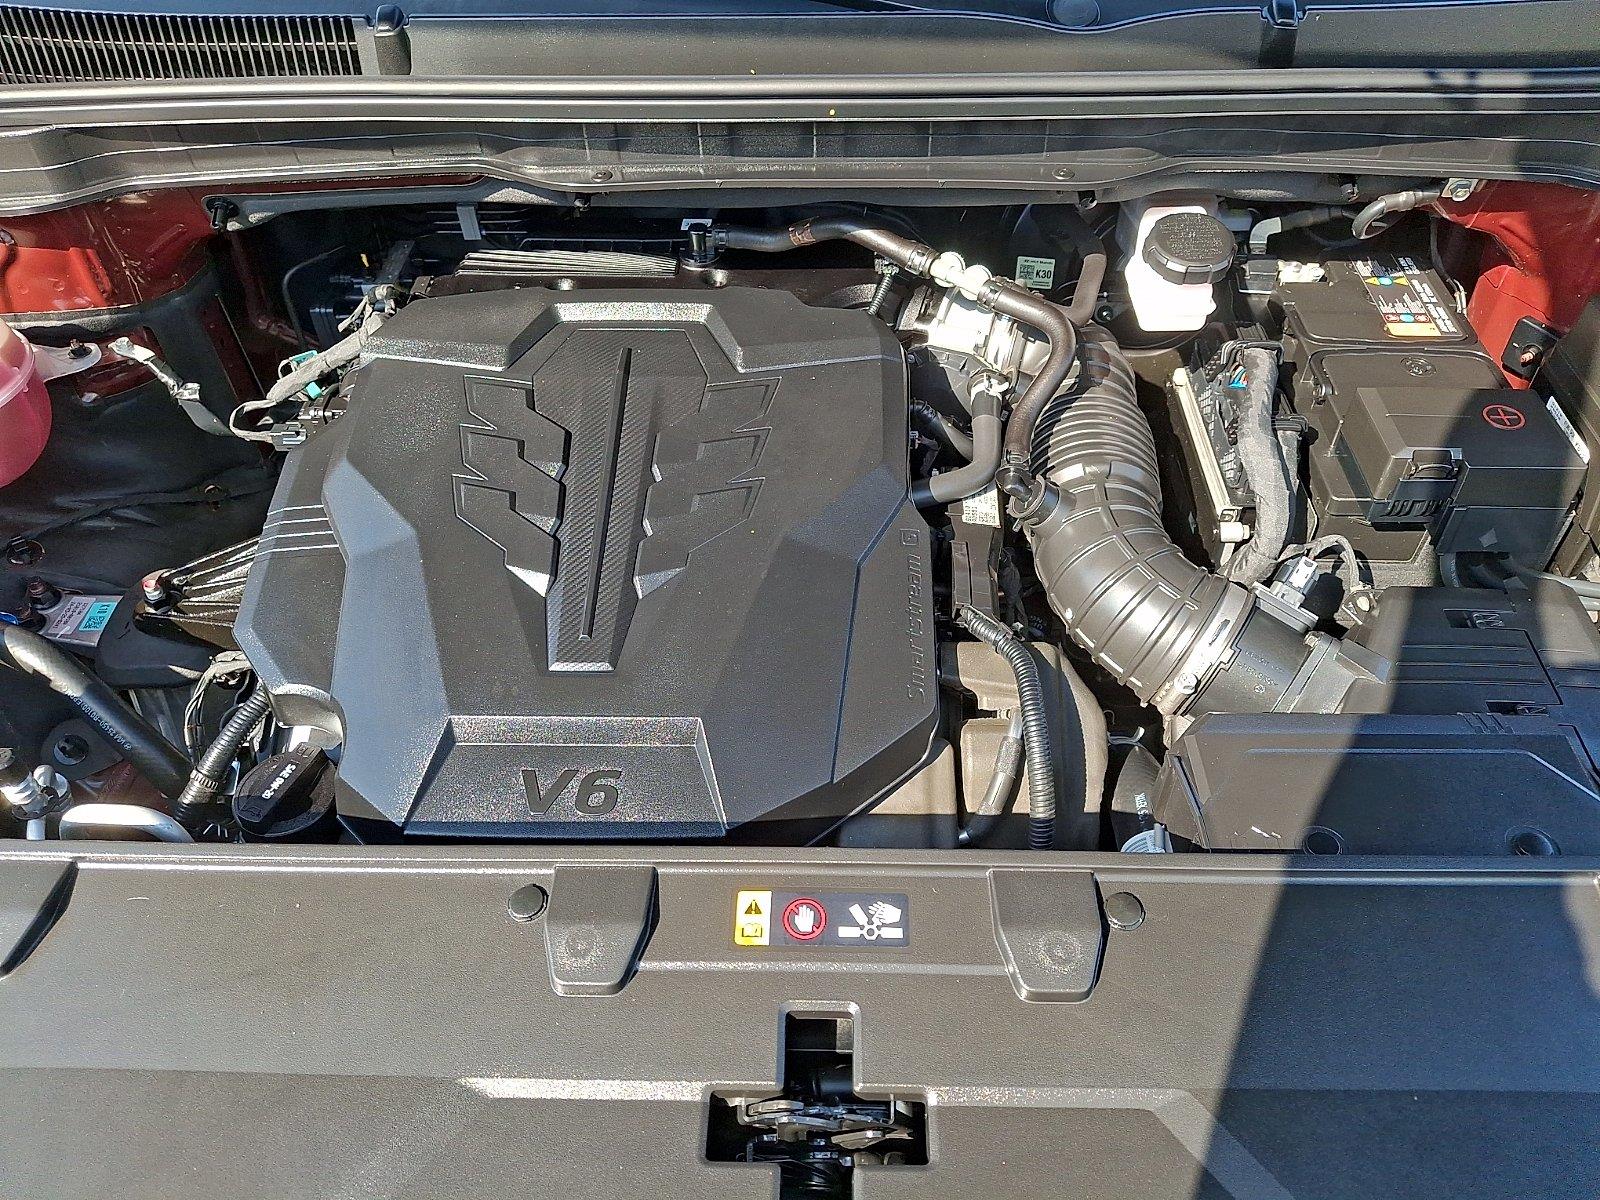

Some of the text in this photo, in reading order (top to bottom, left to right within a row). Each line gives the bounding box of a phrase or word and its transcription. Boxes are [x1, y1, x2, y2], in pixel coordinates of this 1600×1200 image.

[1035, 269, 1052, 279] K30
[907, 554, 925, 703] Smartstream
[280, 763, 297, 778] SAE
[262, 777, 285, 799] 0W-20
[521, 769, 622, 815] V6
